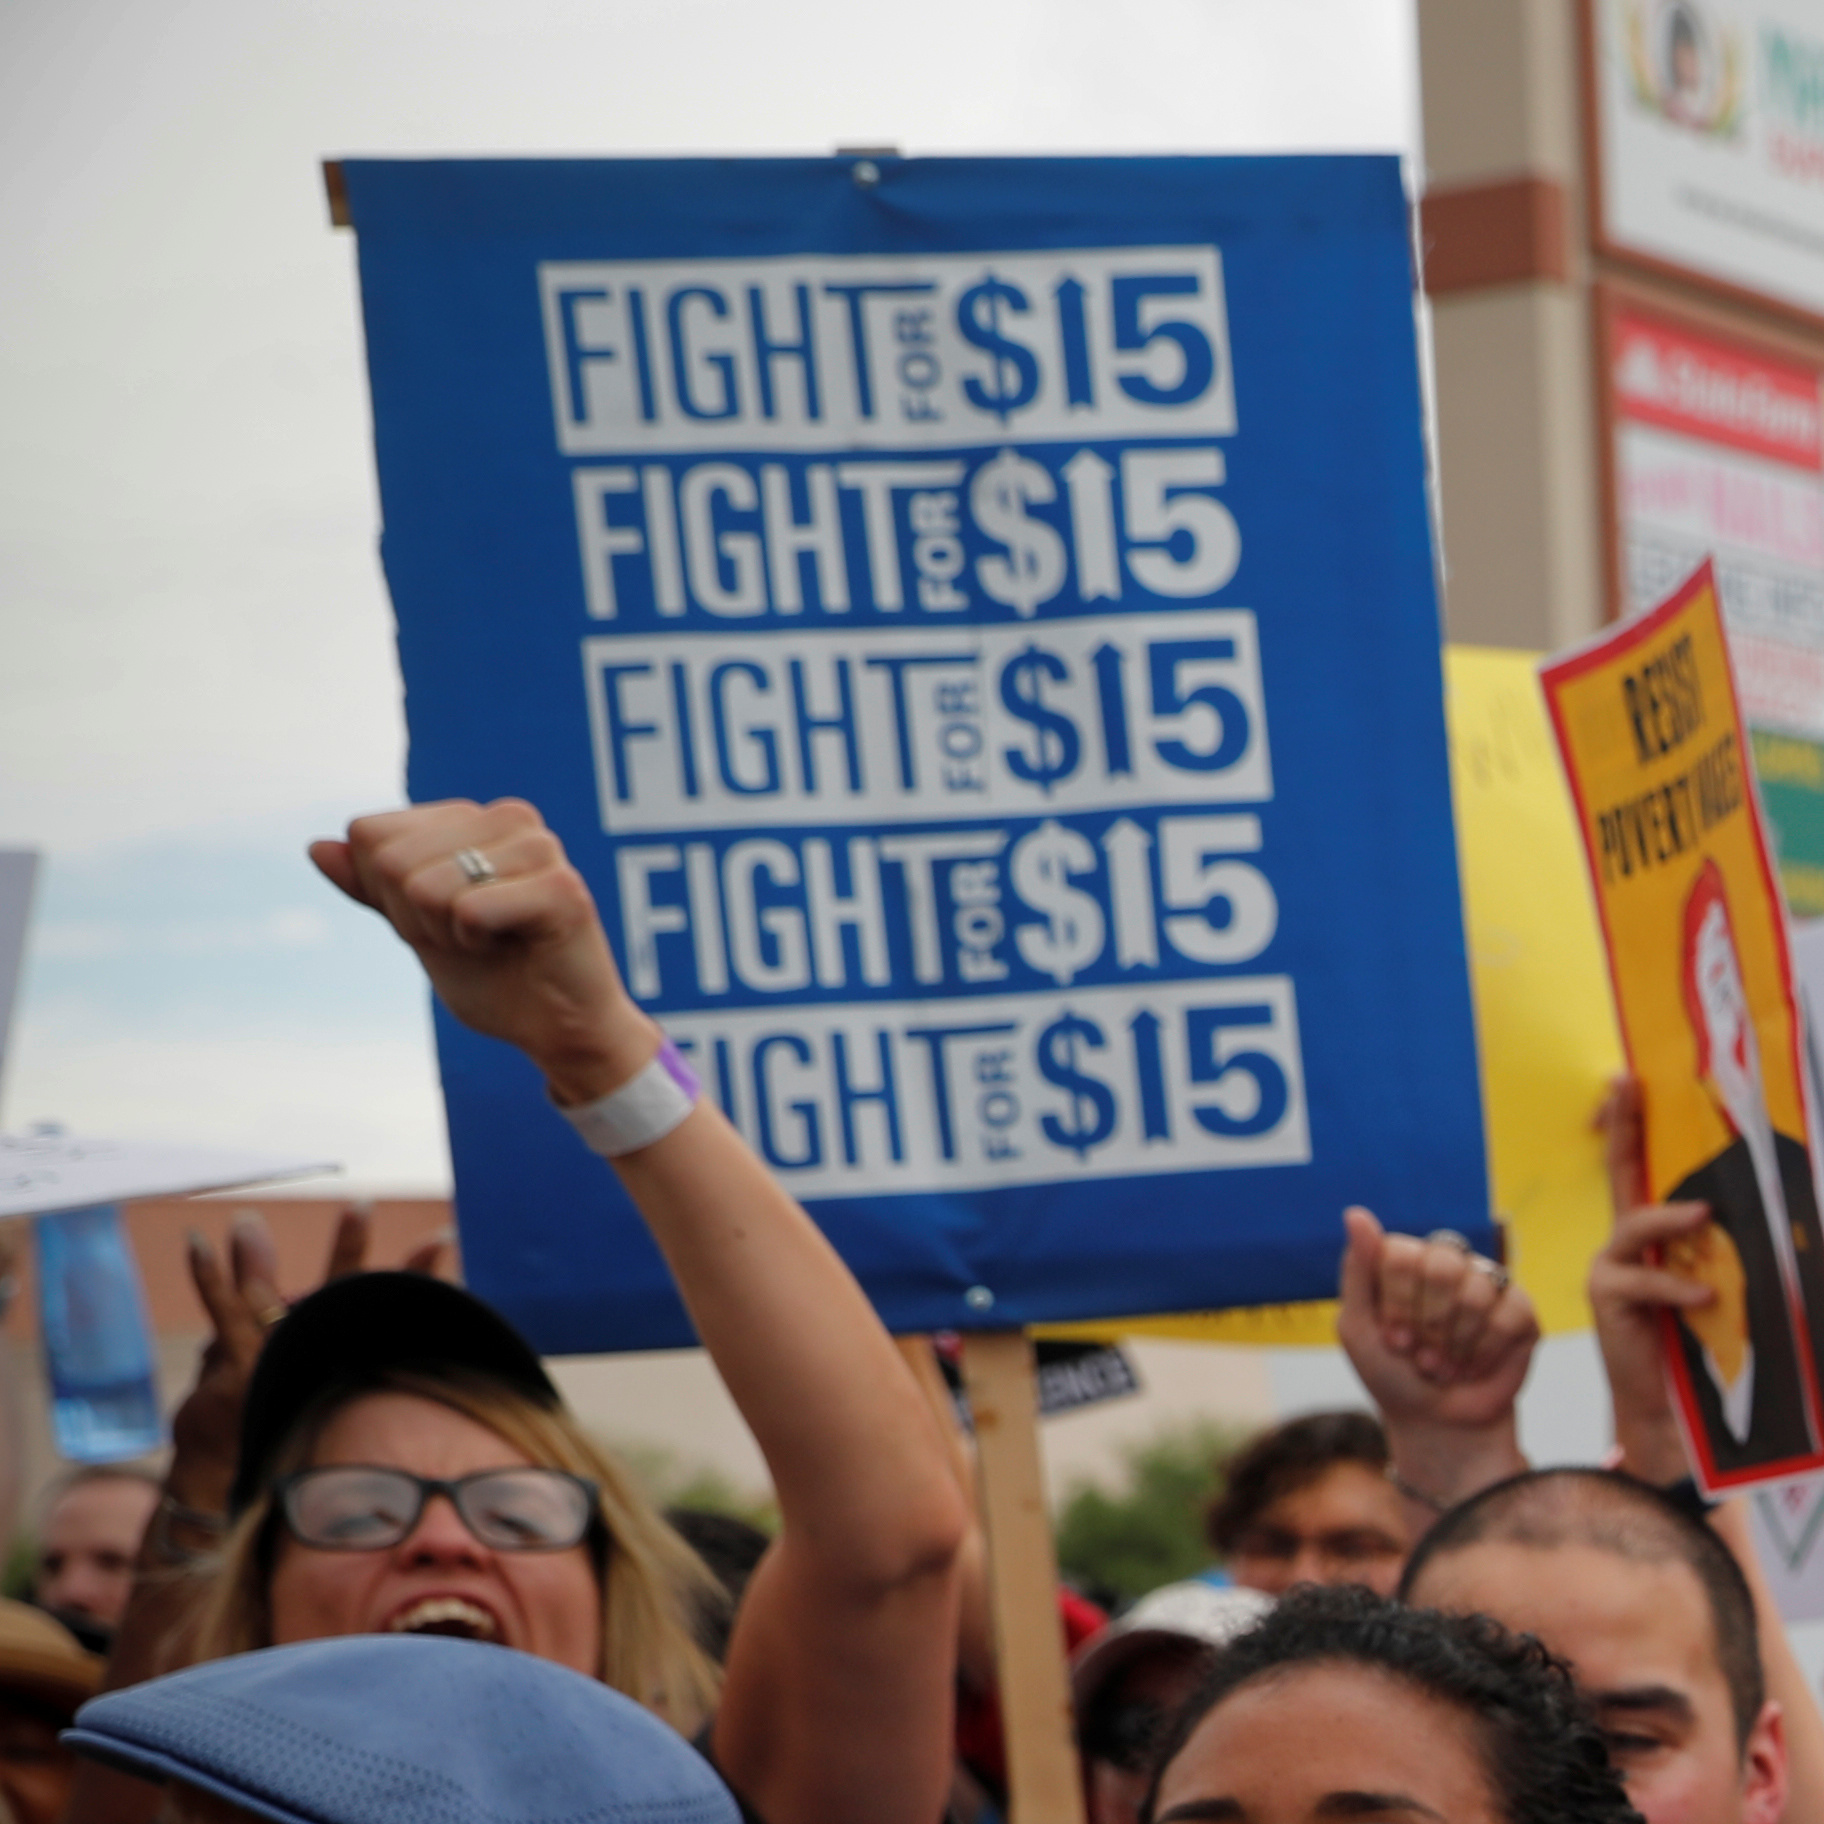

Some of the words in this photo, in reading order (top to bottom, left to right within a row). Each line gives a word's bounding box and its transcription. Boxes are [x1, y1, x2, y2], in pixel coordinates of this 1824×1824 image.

[556, 282, 936, 425] FIGHT
[892, 303, 943, 424] FOR
[954, 269, 1218, 426] $15
[572, 459, 966, 620] FIGHT
[910, 487, 970, 612] FOR
[967, 446, 1243, 619] $15
[600, 652, 978, 803] FIGHT
[935, 677, 988, 794] FOR
[997, 635, 1252, 798] $15
[616, 830, 1008, 999] FIGHT
[952, 860, 1009, 983] FOR
[1008, 812, 1279, 986] $15
[668, 1021, 1016, 1170] IGHT
[976, 1049, 1021, 1162] FOR
[1036, 1003, 1290, 1162] $15
